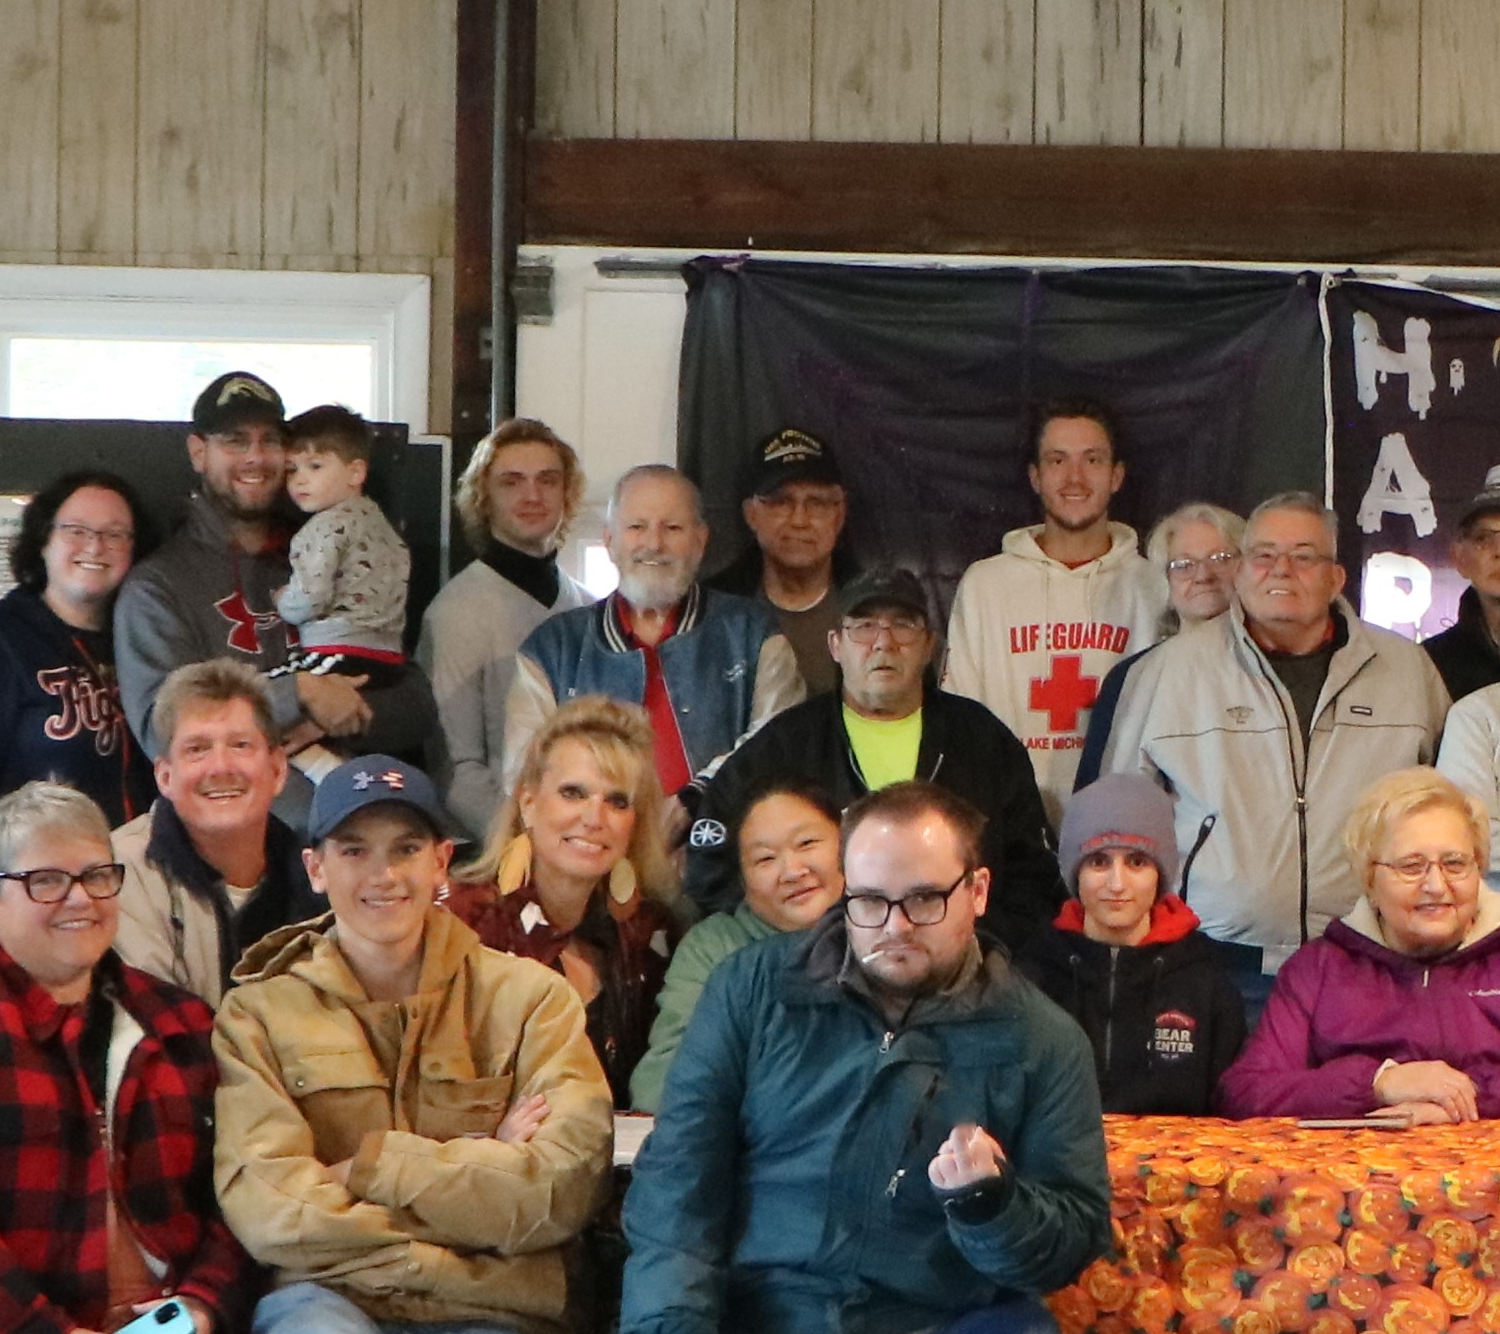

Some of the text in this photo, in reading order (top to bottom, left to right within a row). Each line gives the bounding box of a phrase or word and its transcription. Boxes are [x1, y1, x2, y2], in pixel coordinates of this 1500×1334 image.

[1010, 622, 1130, 654] LIFEGUARD
[36, 666, 120, 756] Tig
[1021, 737, 1087, 750] LAKE MICHI
[1155, 1028, 1191, 1042] BEAR
